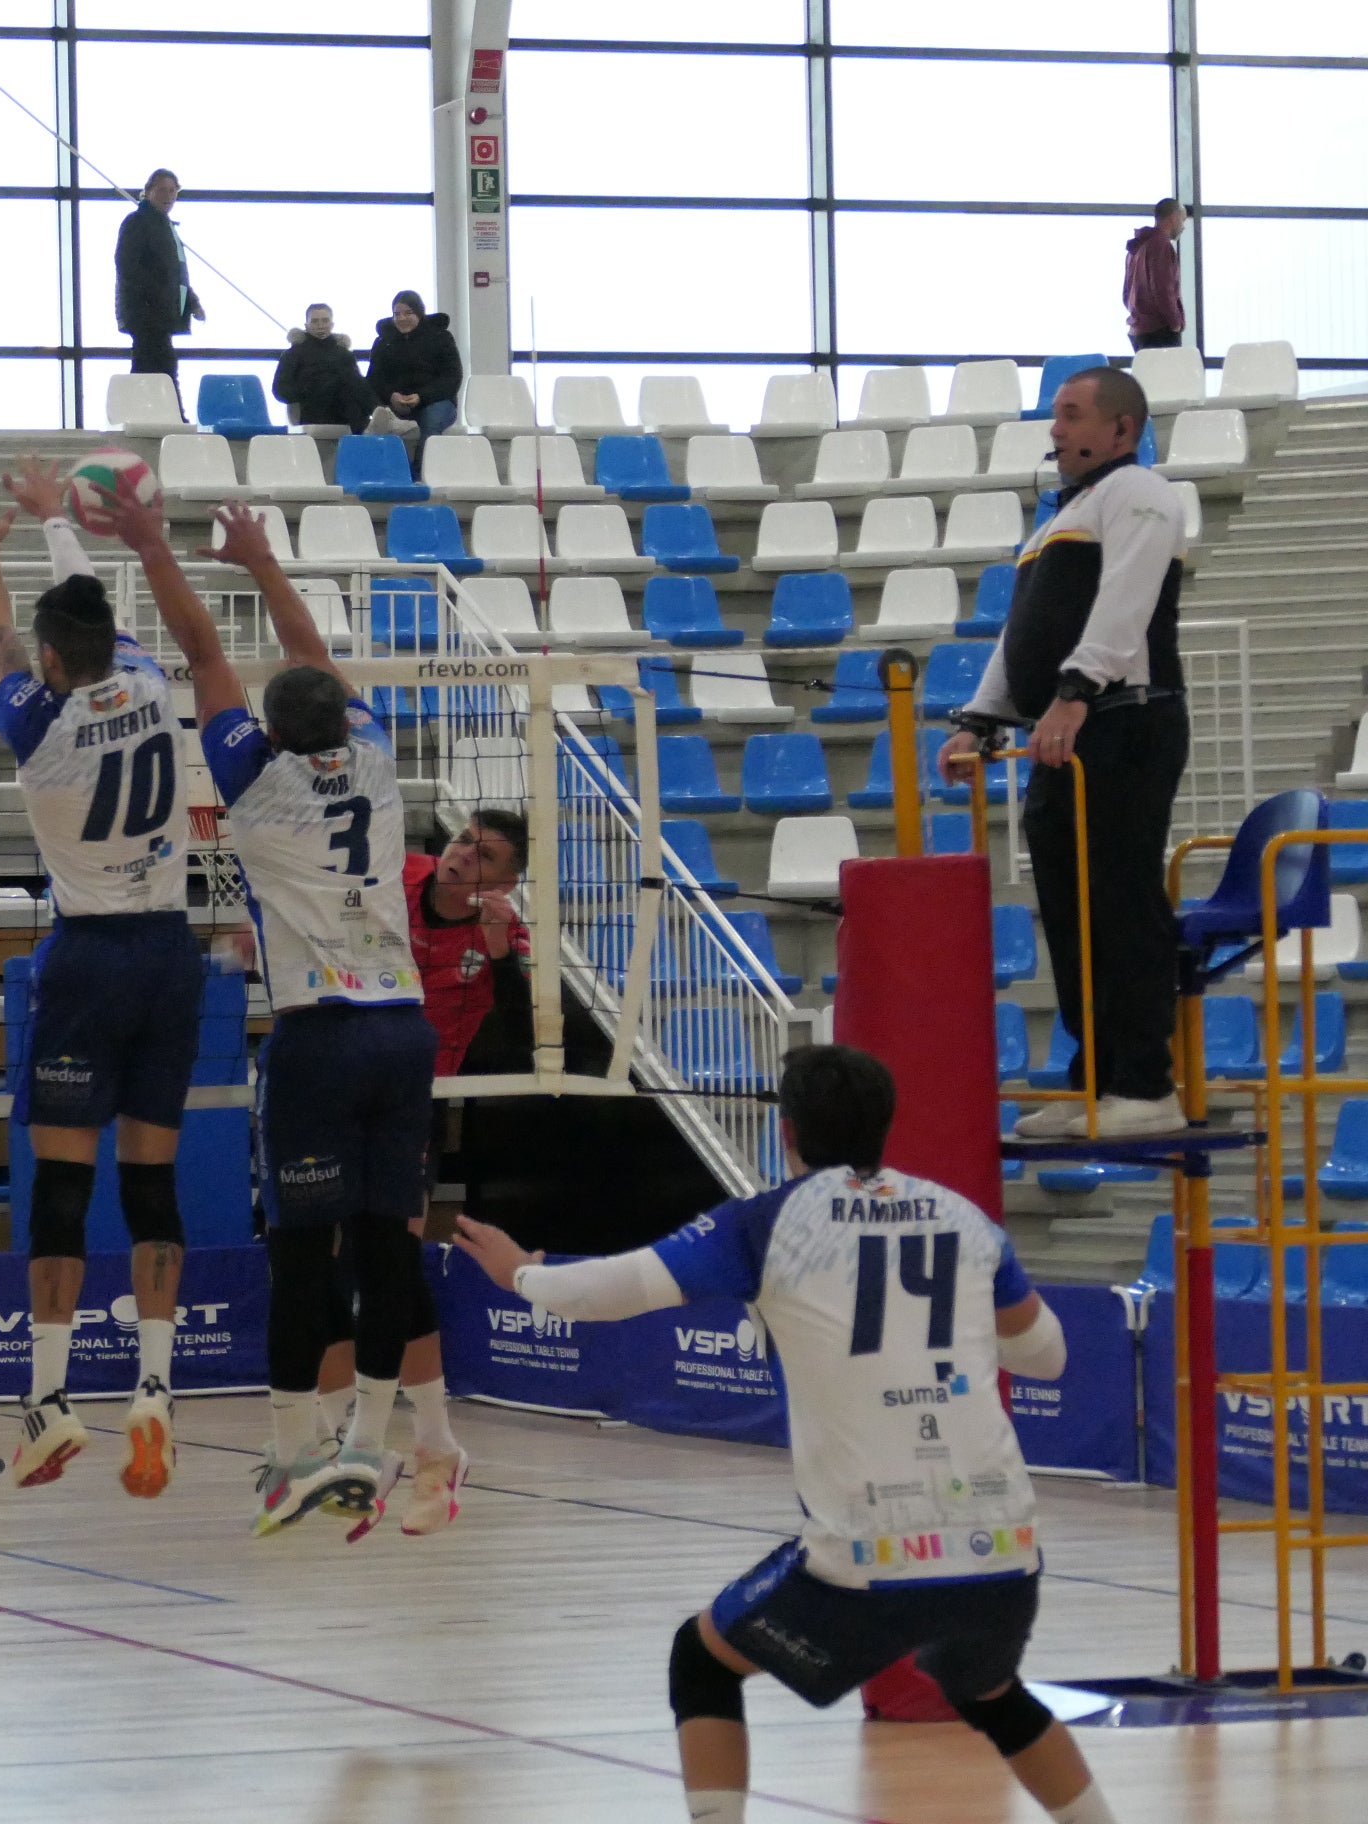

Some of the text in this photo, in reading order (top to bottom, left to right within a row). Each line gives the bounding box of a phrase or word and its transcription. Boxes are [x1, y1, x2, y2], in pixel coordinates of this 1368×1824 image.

[418, 658, 530, 678] rfevb.com
[80, 731, 176, 841] 10
[323, 795, 372, 877] 3
[35, 1066, 93, 1083] Medsur
[280, 1163, 342, 1184] Medsur
[849, 1231, 960, 1357] 14
[172, 1332, 232, 1345] TENNIS
[97, 1351, 131, 1360] tienda
[675, 1361, 763, 1382] PROFESSIONAL TABLE
[883, 1386, 950, 1408] suma
[1025, 1388, 1061, 1402] TENNIS
